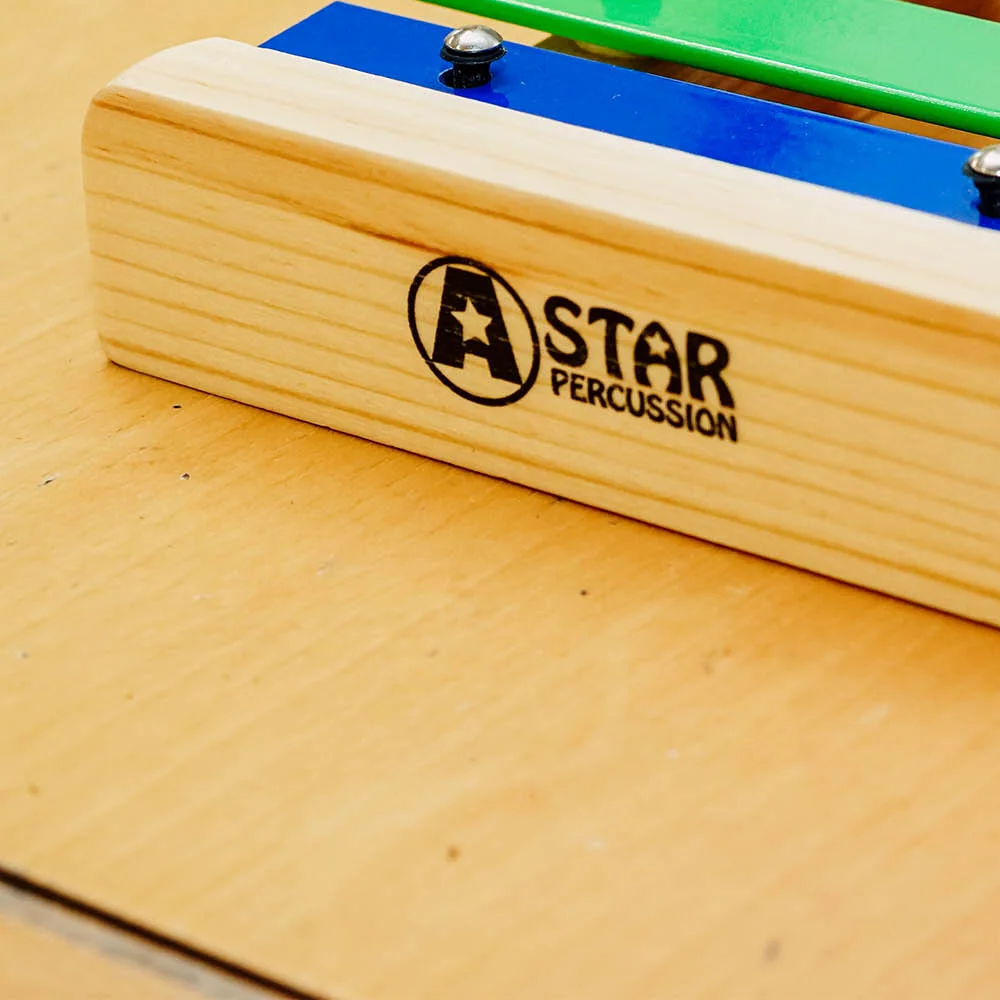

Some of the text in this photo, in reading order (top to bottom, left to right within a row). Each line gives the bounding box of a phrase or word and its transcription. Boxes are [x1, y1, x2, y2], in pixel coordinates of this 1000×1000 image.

[431, 264, 735, 410] A STAR
[550, 367, 739, 443] PERCUSSION
